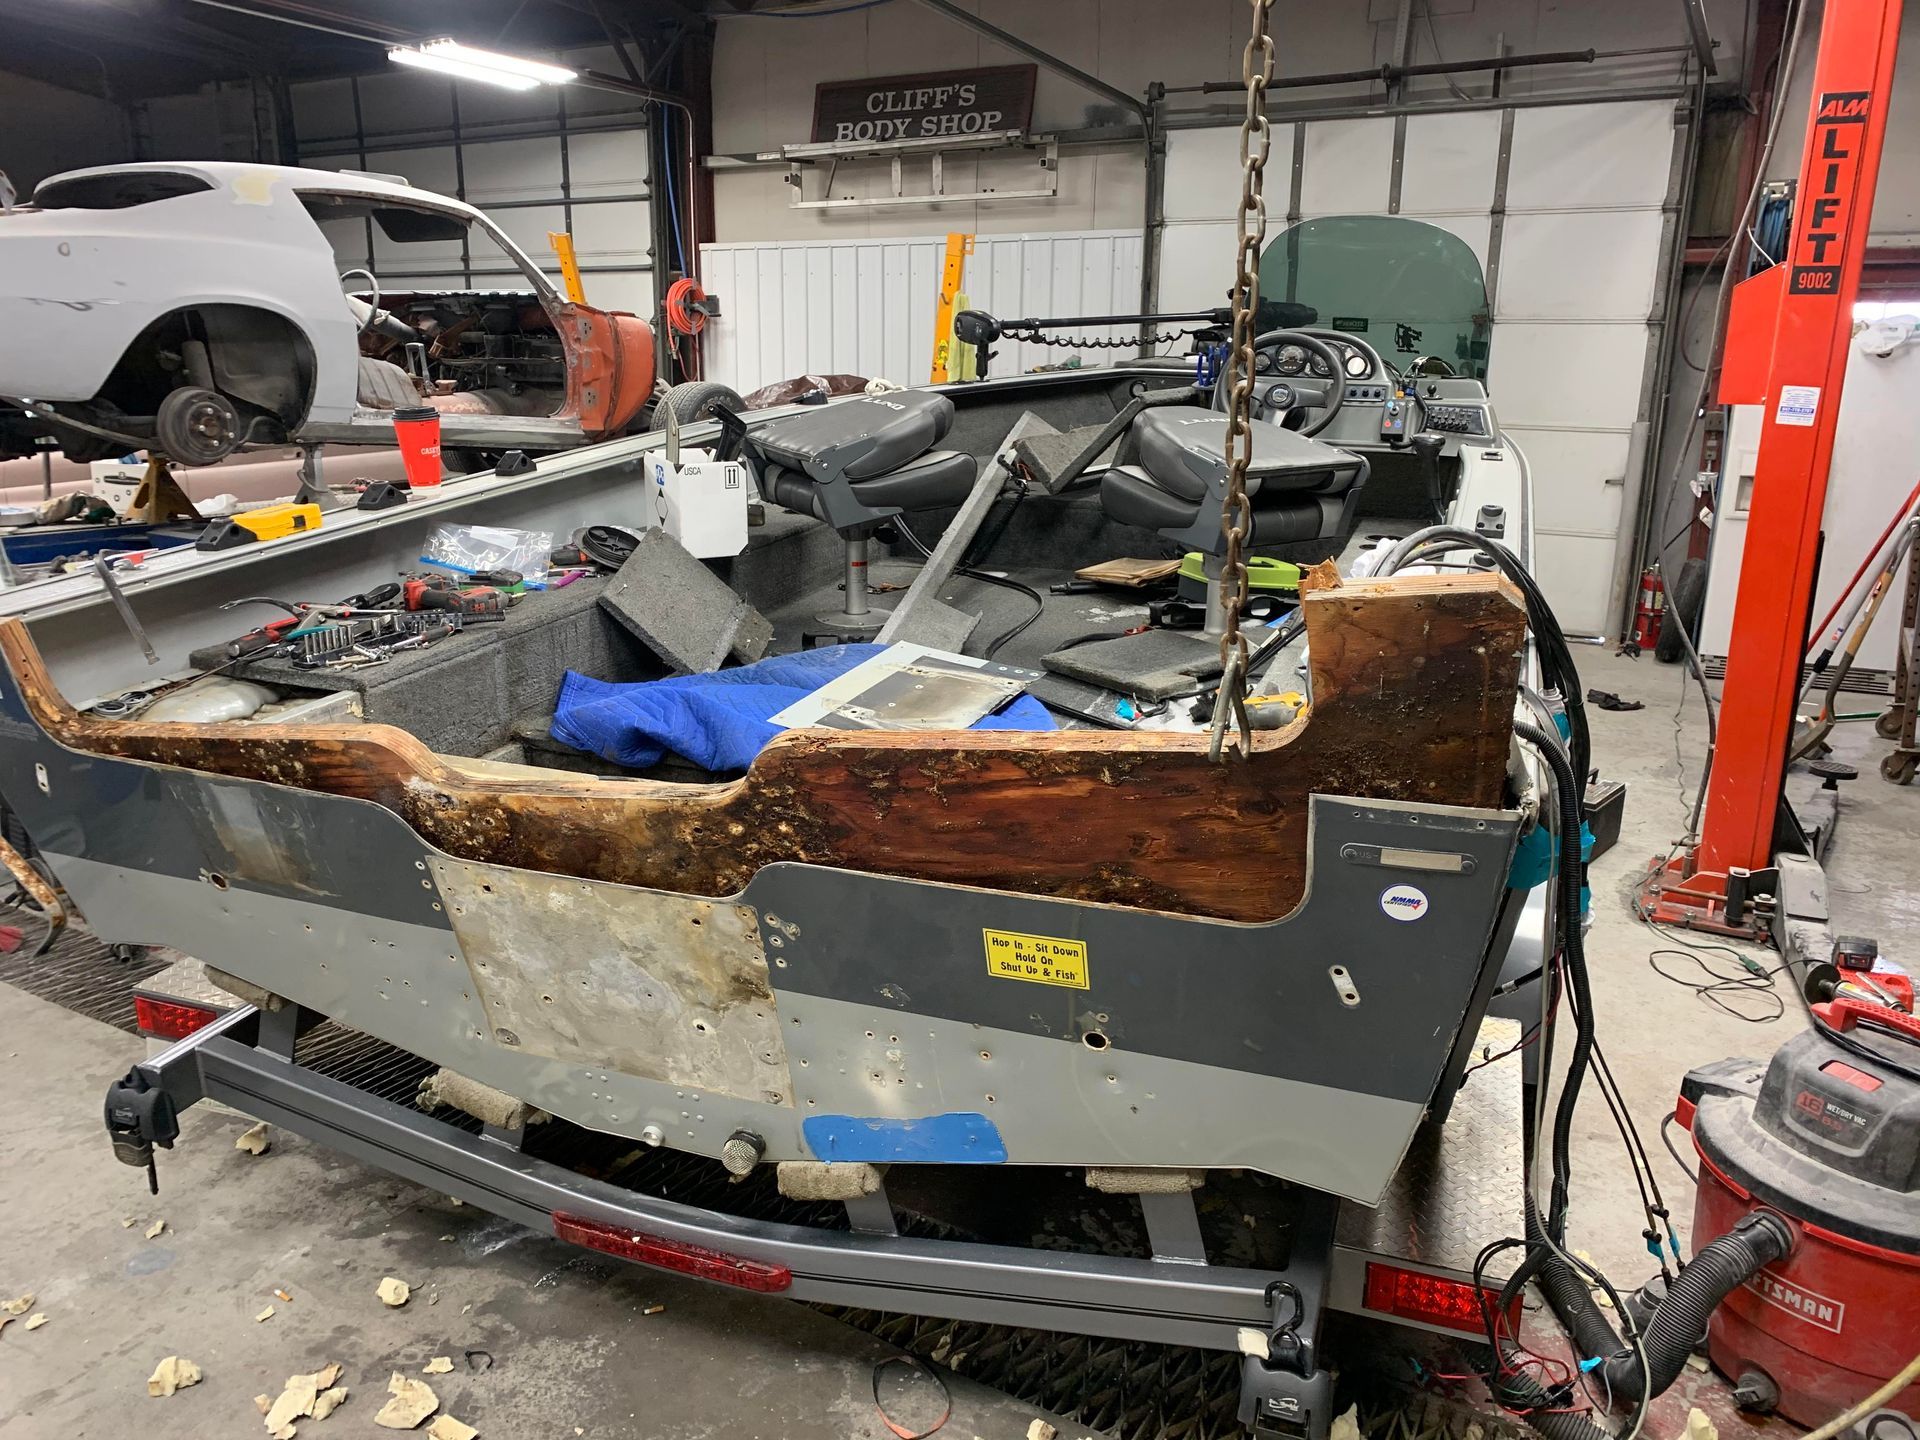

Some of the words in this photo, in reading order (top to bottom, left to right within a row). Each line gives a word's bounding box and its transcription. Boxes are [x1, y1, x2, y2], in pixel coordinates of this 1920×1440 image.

[866, 84, 977, 114] CLIFF'S
[1818, 98, 1868, 118] ALM
[834, 117, 912, 142] BODY
[920, 111, 1002, 137] SHOP
[1807, 128, 1849, 263] LIFT
[1798, 271, 1833, 289] 9002
[684, 466, 702, 476] USCA
[992, 937, 1009, 948] Hop
[1014, 940, 1023, 950] In
[1035, 943, 1048, 953] Sit
[1053, 945, 1079, 958] Down
[1015, 952, 1036, 963] Hold
[1040, 955, 1054, 966] On
[1000, 961, 1022, 973] Shut
[1025, 965, 1038, 975] Up
[1043, 968, 1051, 977] &
[1055, 969, 1076, 981] Fish
[1826, 1102, 1854, 1120] WET/DRY
[1854, 1114, 1867, 1126] VAC
[1748, 1272, 1833, 1322] FTSMAN
